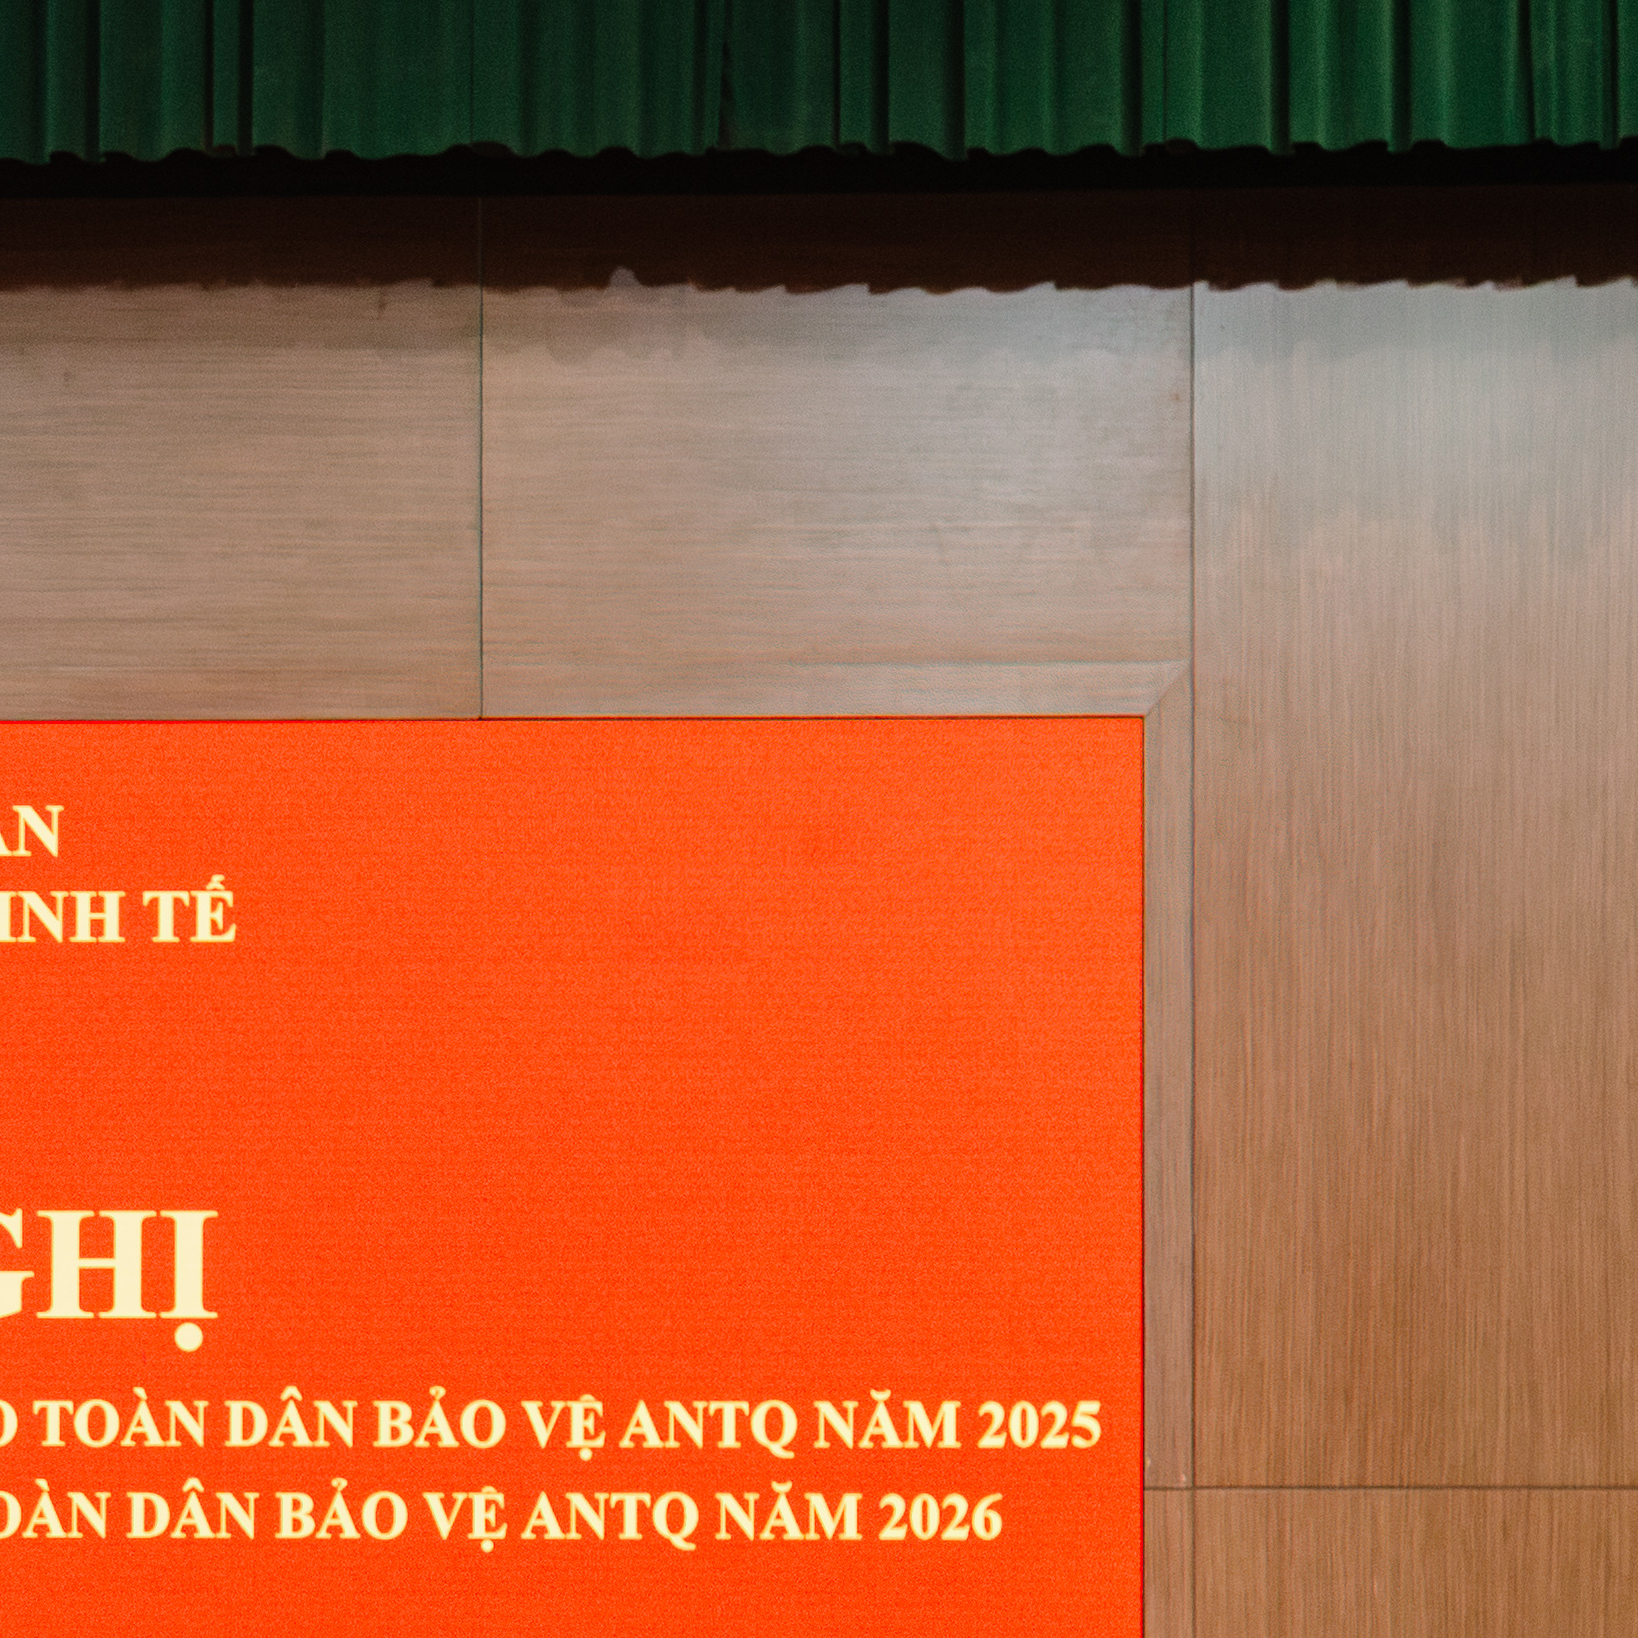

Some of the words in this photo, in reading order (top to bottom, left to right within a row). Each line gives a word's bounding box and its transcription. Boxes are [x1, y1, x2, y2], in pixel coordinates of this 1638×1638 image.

[143, 875, 237, 944] TẾ
[34, 1388, 210, 1449] TOÀN
[226, 1387, 359, 1448] DÂN
[374, 1386, 507, 1450] BẢO
[522, 1395, 607, 1462] VỆ
[620, 1400, 799, 1460] ANTQ
[815, 1390, 962, 1450] NĂM
[979, 1402, 1102, 1449] 2025
[127, 1478, 261, 1540] DÂN
[276, 1478, 409, 1541] BẢO
[424, 1487, 508, 1554] VỆ
[522, 1492, 700, 1552] ANTQ
[717, 1482, 863, 1542] NĂM
[880, 1494, 1003, 1541] 2026
